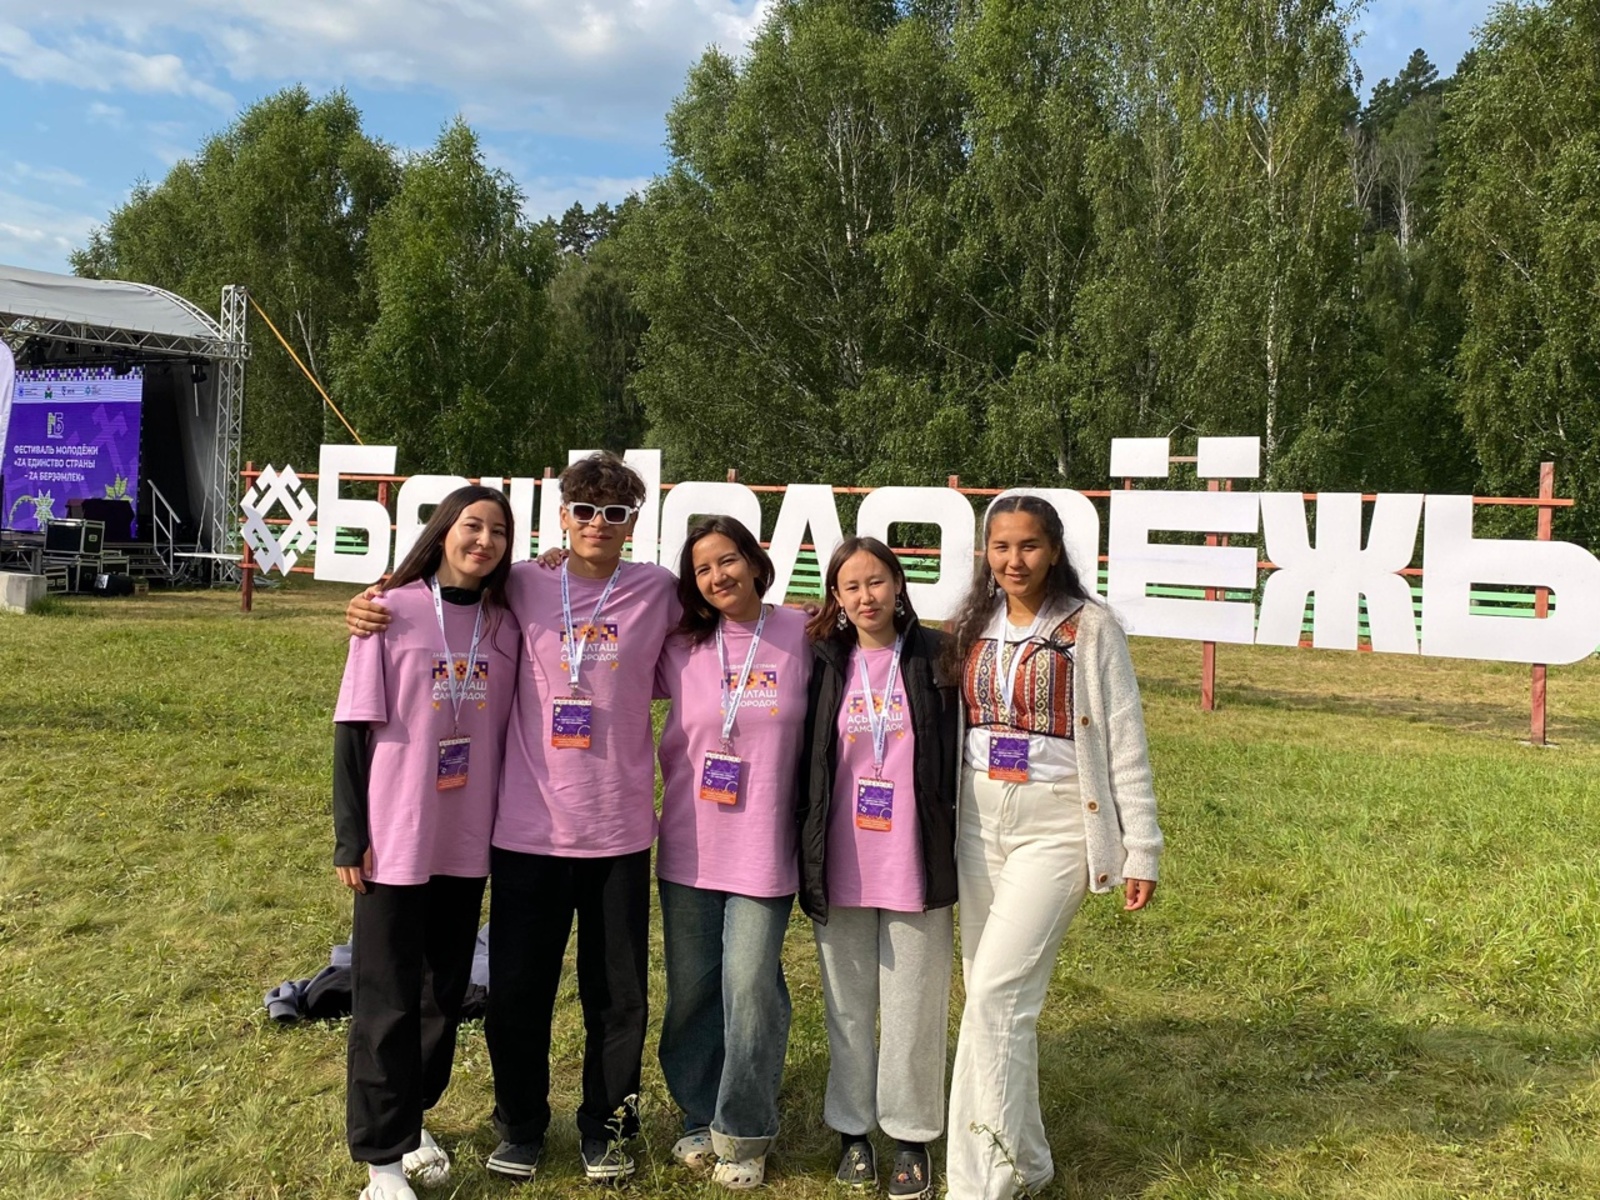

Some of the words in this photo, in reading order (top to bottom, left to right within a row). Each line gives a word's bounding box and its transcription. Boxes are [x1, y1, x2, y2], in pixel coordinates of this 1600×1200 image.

[14, 445, 54, 455] ФЕСТИВАЛЬ
[56, 444, 98, 456] МОЛОДЁЖИ
[27, 459, 64, 469] ЕДИНСТВО
[65, 459, 96, 468] СТРАНЫ
[560, 643, 618, 652] АЛТАШ
[560, 653, 619, 661] СОРОДОК
[432, 681, 487, 691] АҪЛАШ
[432, 692, 486, 700] САМРДОК
[721, 700, 777, 708] СОРОДОК
[847, 722, 904, 733] САМОДОК
